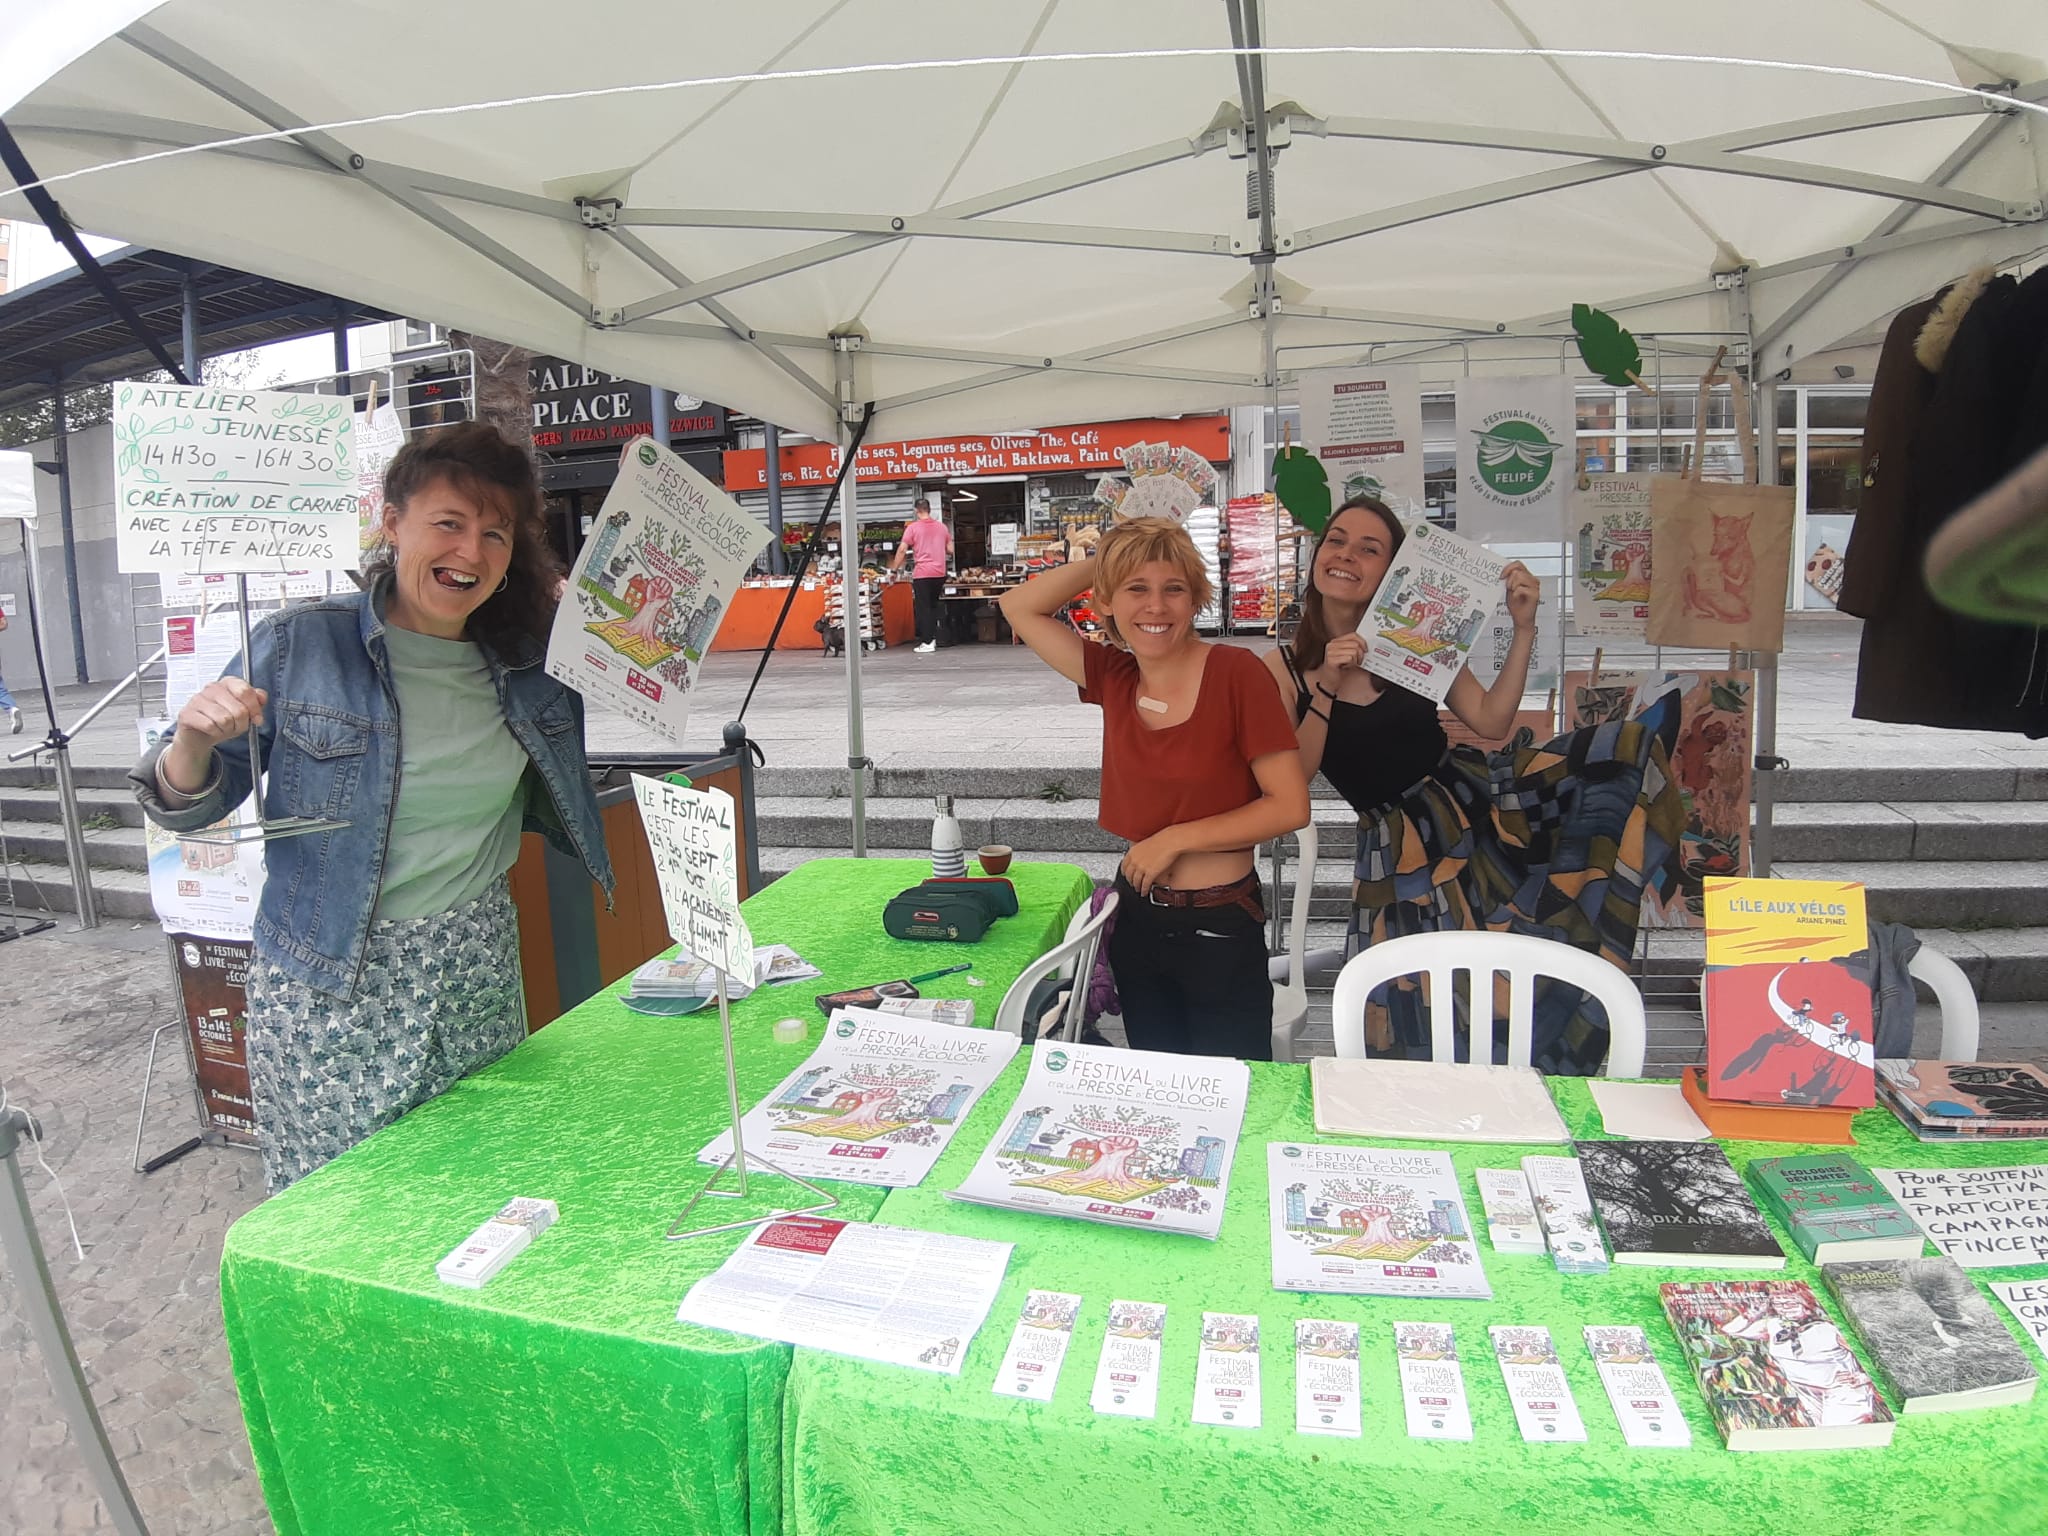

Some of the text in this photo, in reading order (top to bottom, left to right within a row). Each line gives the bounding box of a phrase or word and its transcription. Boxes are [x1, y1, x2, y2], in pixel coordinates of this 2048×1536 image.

[527, 363, 599, 393] CALE
[532, 392, 632, 427] PLACE
[1483, 410, 1526, 426] FESTIVAL
[203, 418, 332, 445] JEUNESSE
[570, 426, 607, 442] PIZZAS
[611, 421, 653, 437] PANINIS
[669, 416, 715, 433] ZZWICH
[831, 446, 869, 461] Fts
[903, 443, 956, 458] Legumes
[990, 436, 1031, 450] Olives
[1071, 431, 1099, 446] Café
[758, 470, 796, 483] Eces,
[800, 466, 822, 480] Riz,
[826, 464, 883, 479] Cocous,
[975, 452, 1007, 469] Miel,
[1012, 450, 1074, 467] Baklawa,
[1079, 447, 1109, 463] Pain
[1495, 469, 1535, 483] FELIPÉ
[1594, 481, 1641, 492] FESTIVAL
[128, 487, 358, 513] CRÉATION DE CARNETS
[655, 483, 694, 520] PRESSE
[657, 462, 709, 514] FESTIVAL
[716, 512, 752, 545] LIVRE
[130, 517, 170, 533] AVEC
[183, 518, 217, 533] LES
[150, 540, 171, 556] LA
[1427, 534, 1503, 575] FESTIVAL LIVRE
[643, 785, 731, 830] LE FESTIVAL
[682, 825, 710, 848] LES
[1729, 897, 1846, 916] L'ÎLE AUX VÉLOS
[674, 911, 686, 931] DU
[1796, 917, 1847, 926] ARIANE PINEL
[204, 955, 226, 968] LIVRE
[213, 945, 249, 959] FESTIVAL
[197, 1016, 207, 1029] 13
[214, 1019, 225, 1032] 14
[199, 1029, 227, 1041] OCTOBRE
[858, 1028, 926, 1049] FESTIVAL
[943, 1039, 988, 1055] LIVRE
[860, 1043, 910, 1057] PRESSE
[1072, 1060, 1152, 1086] FESTIVAL
[1171, 1073, 1222, 1095] LIVRE
[1077, 1079, 1135, 1097] PRESSE
[1307, 1151, 1376, 1164] FESTIVAL
[1391, 1156, 1432, 1166] LIVRE
[1316, 1161, 1362, 1172] PRESSE
[1894, 1166, 2048, 1185] POUR SOUTENI
[1902, 1180, 2048, 1199] LE FESTIVA
[1652, 1215, 1723, 1225] DIX ANS
[1929, 1216, 2048, 1235] CAMPAGN
[1938, 1235, 2048, 1254] FINCEM
